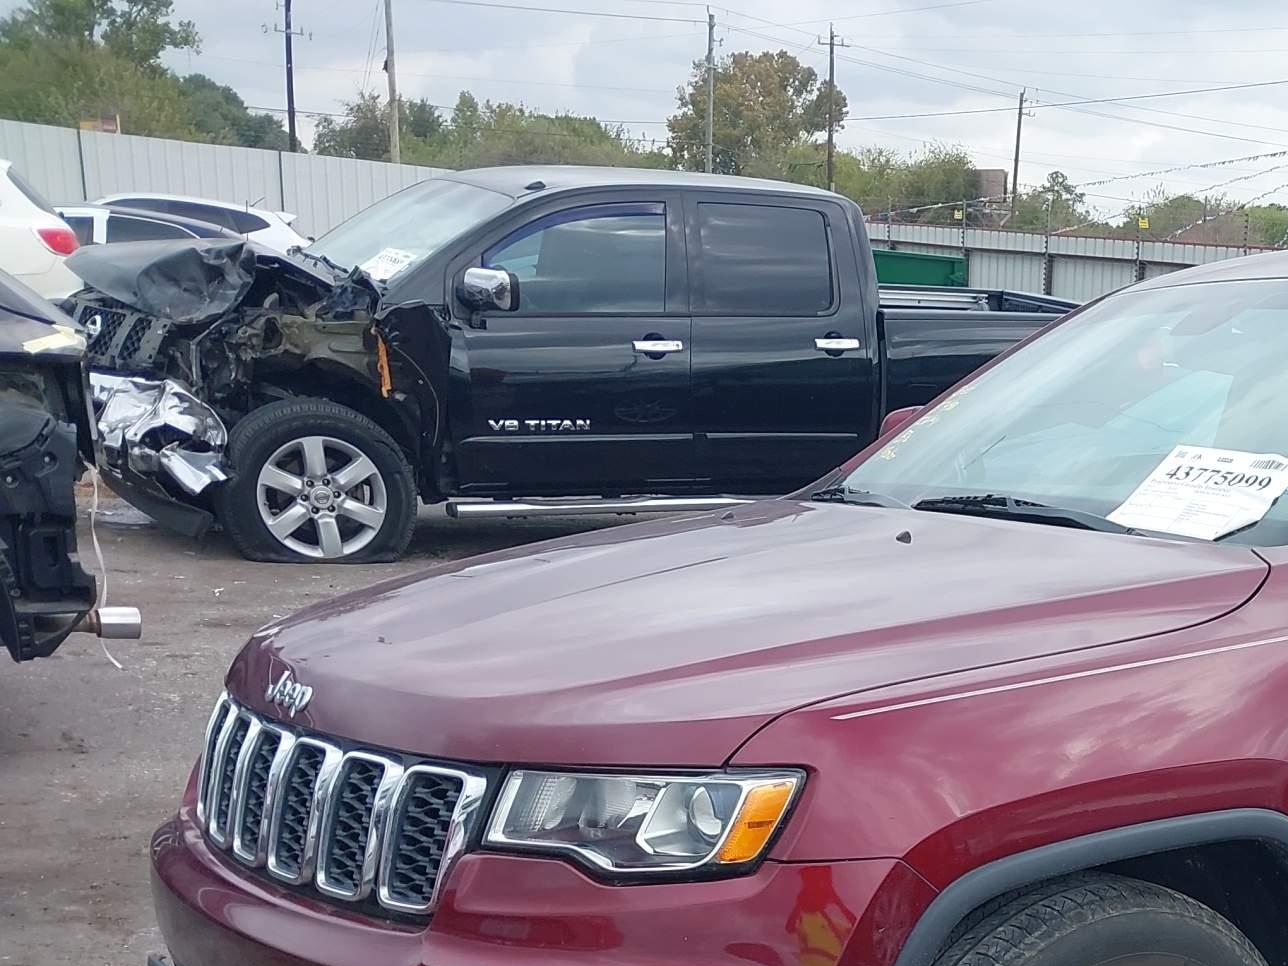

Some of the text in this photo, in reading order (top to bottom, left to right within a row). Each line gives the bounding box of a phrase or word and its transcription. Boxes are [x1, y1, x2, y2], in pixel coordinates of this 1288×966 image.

[487, 419, 591, 431] V8 TITAN
[1165, 464, 1273, 492] 43775099
